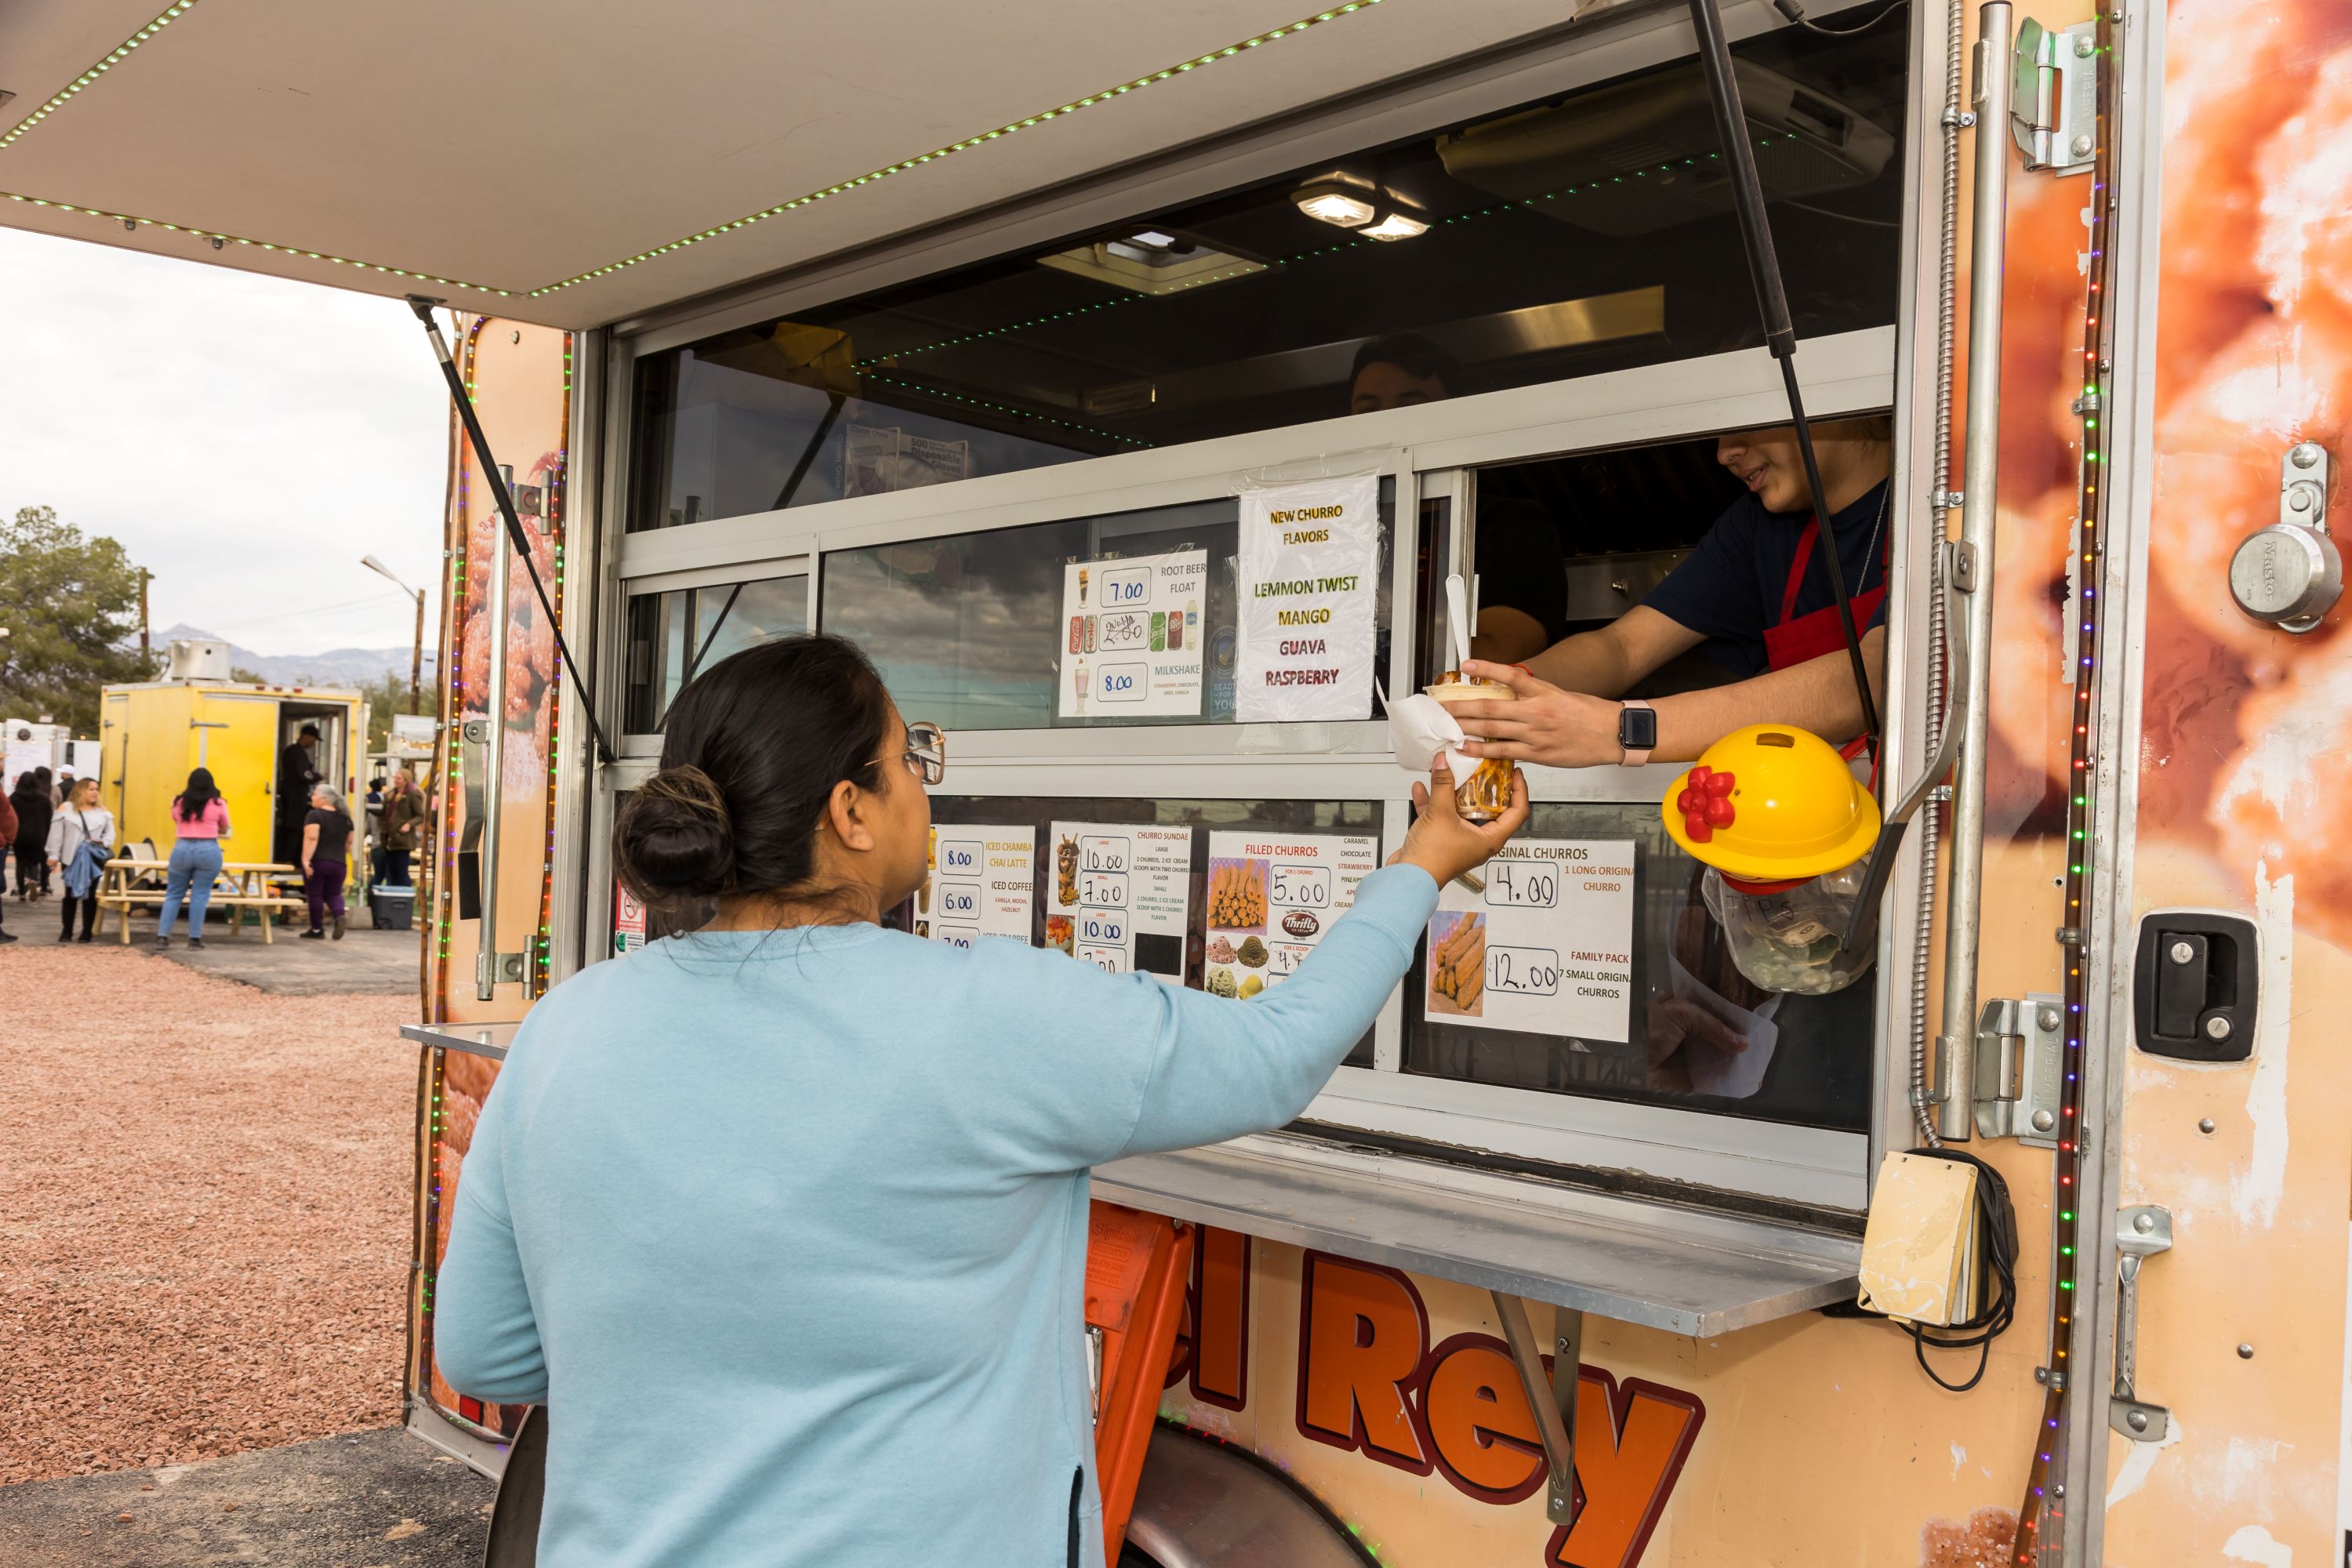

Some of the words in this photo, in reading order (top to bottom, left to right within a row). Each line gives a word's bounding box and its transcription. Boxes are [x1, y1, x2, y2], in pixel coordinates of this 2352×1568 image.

[910, 437, 928, 448] 500
[910, 447, 960, 465] Disposable
[931, 460, 960, 473] Gloves
[1270, 510, 1295, 524] NEW
[1297, 505, 1343, 522] CHURRO
[1283, 529, 1329, 545] FLAVORS
[1161, 565, 1184, 576] ROOT
[1186, 563, 1206, 574] BEER
[2263, 541, 2276, 602] Master
[1110, 583, 1143, 601] 7.00
[1170, 583, 1196, 593] FLOAT
[1254, 578, 1314, 598] LEMMON
[1317, 575, 1358, 593] TWIST
[1278, 608, 1330, 626] MANGO
[1279, 639, 1327, 656] GUAVA
[1154, 665, 1200, 676] MILKSHAKE
[1265, 669, 1339, 687] RASPBERRY
[1105, 675, 1132, 691] 8.00
[1137, 831, 1162, 840] CHURRO
[985, 841, 1001, 851] ICED
[1002, 842, 1033, 853] CHAMBA
[1245, 844, 1273, 855] FILLED
[1275, 845, 1318, 857] CHURROS
[1493, 847, 1531, 858] GINAL
[1534, 848, 1588, 860] CHURROS
[948, 851, 971, 866] 8.00
[989, 858, 1004, 868] CHAI
[1004, 858, 1027, 869] LATTE
[1087, 848, 1123, 870] 10.00
[1572, 866, 1596, 876] LONG
[991, 881, 1005, 891] ICED
[1007, 881, 1033, 892] COFFEE
[1085, 878, 1121, 903] 7.00
[1273, 874, 1324, 902] 5.00
[1497, 866, 1553, 905] 4.00
[1583, 882, 1621, 892] CHURRO
[946, 893, 972, 909] 6.00
[1085, 920, 1121, 940] 10.00
[1285, 916, 1317, 932] Thrifty
[1571, 950, 1603, 963] FAMILY
[1606, 953, 1629, 964] PACK
[1494, 953, 1556, 989] 12.00
[1559, 969, 1563, 978] 7
[1566, 969, 1595, 981] SMALL
[1596, 972, 1631, 983] ORIGIN
[1577, 986, 1620, 999] CHURROS
[2034, 1037, 2059, 1105] IMPERIAL
[1296, 1247, 1706, 1568] Rey
